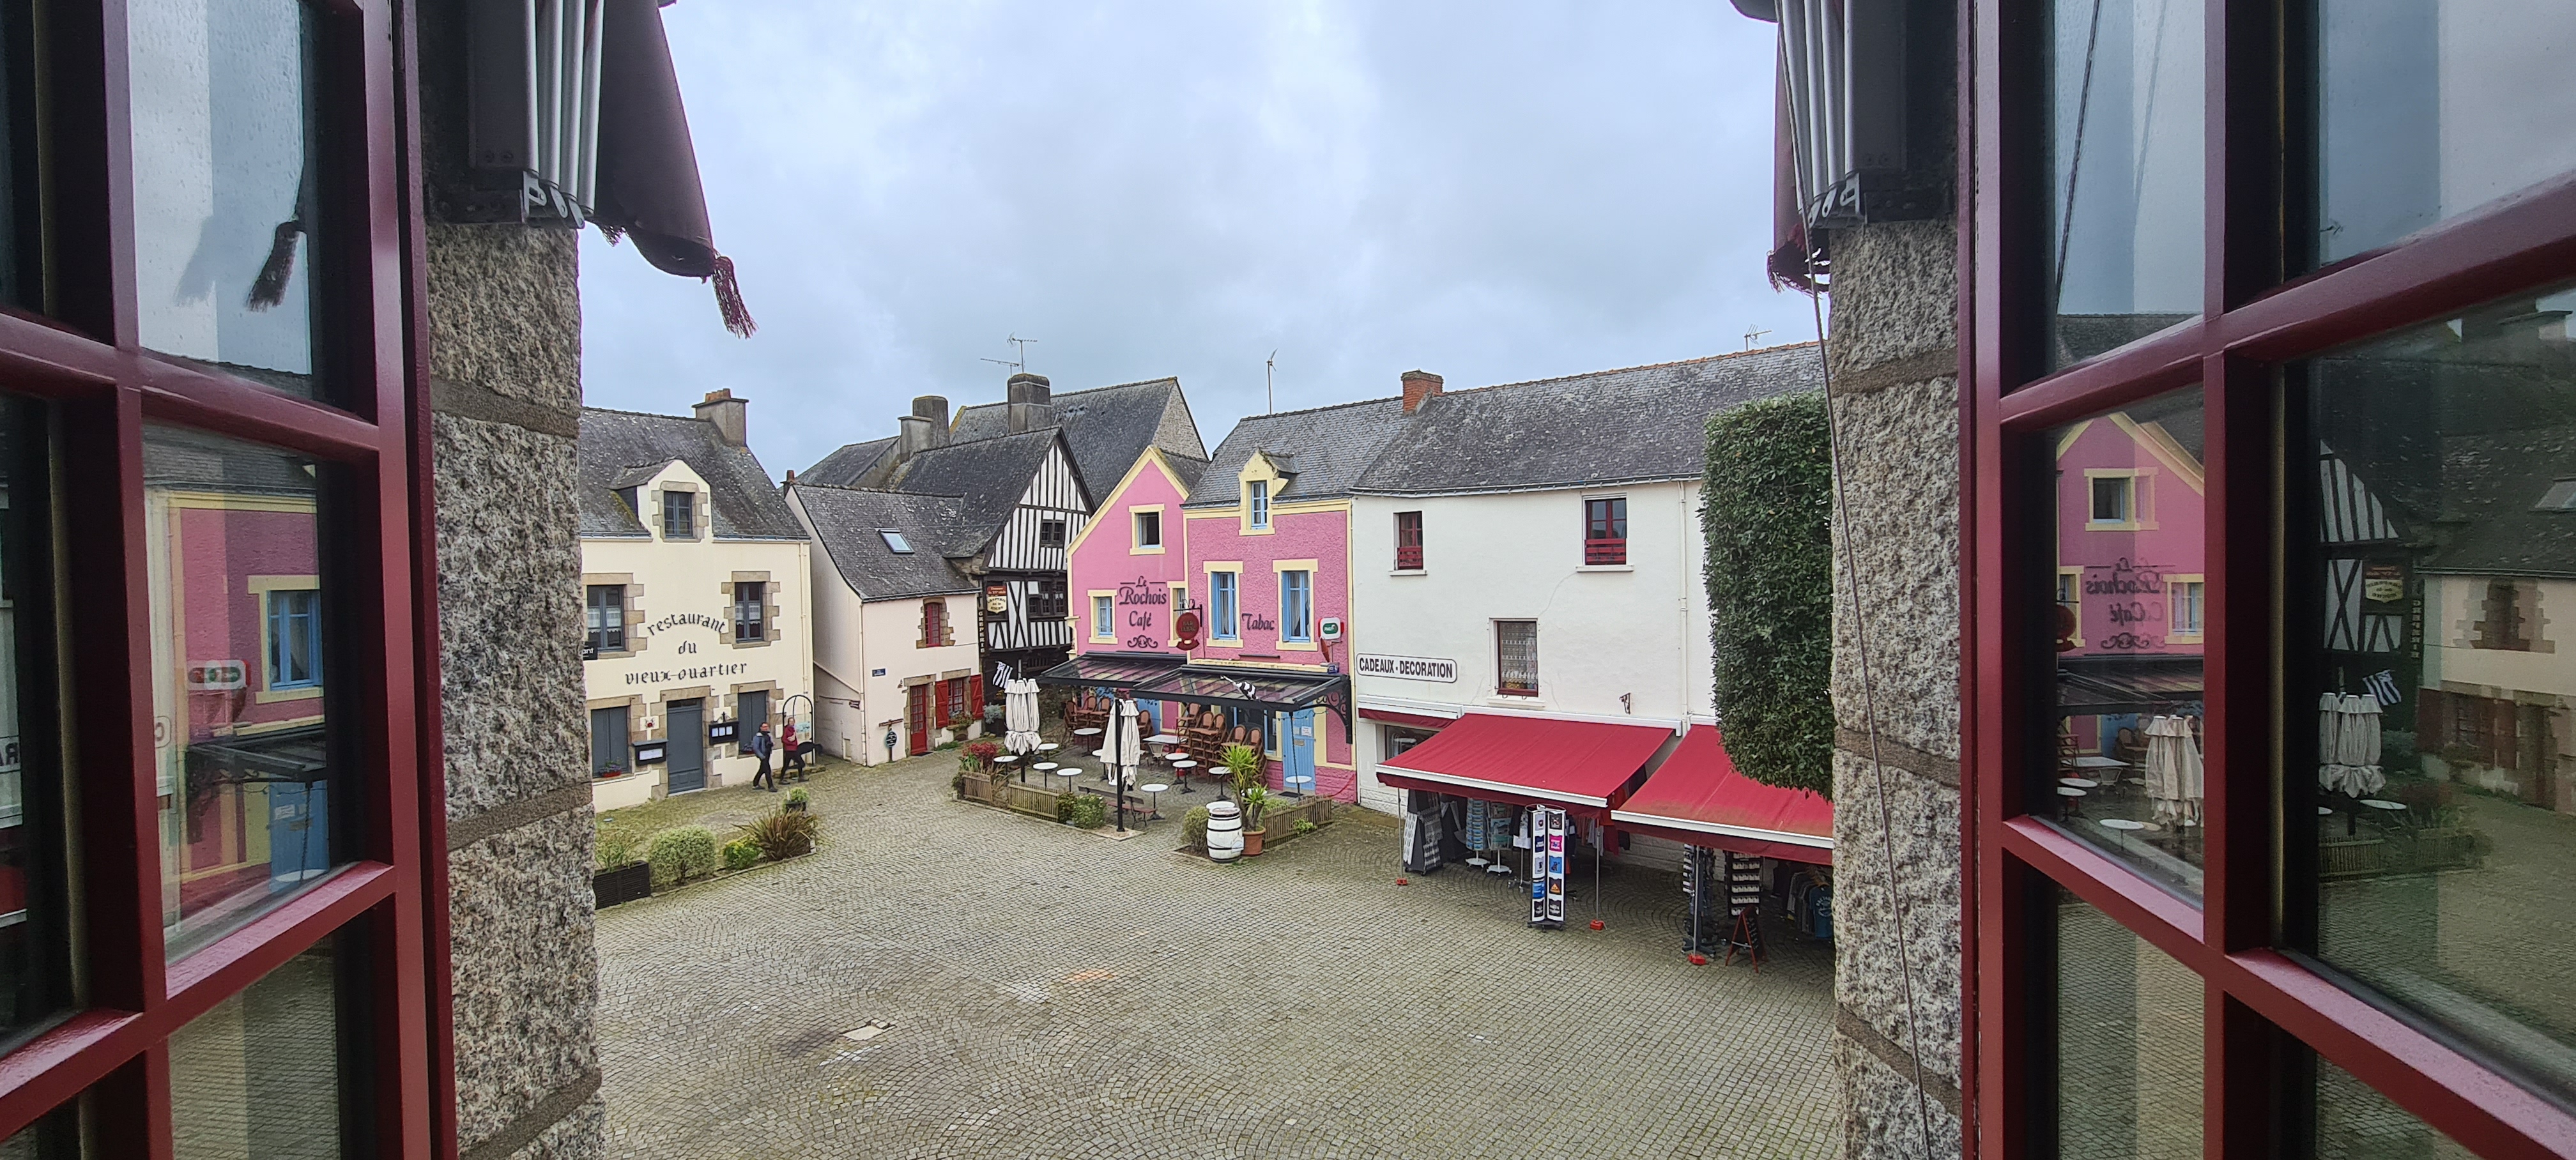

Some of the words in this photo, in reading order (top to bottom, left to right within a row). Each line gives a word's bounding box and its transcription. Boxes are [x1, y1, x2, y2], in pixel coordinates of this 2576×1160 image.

[1135, 576, 1147, 588] Le
[1119, 586, 1167, 606] Rochois
[647, 613, 725, 636] restaurant
[1129, 610, 1152, 631] Café
[1241, 613, 1275, 630] Tabac
[678, 641, 697, 655] du
[1359, 657, 1395, 674] CADEAUX
[1399, 660, 1453, 678] DECORATION
